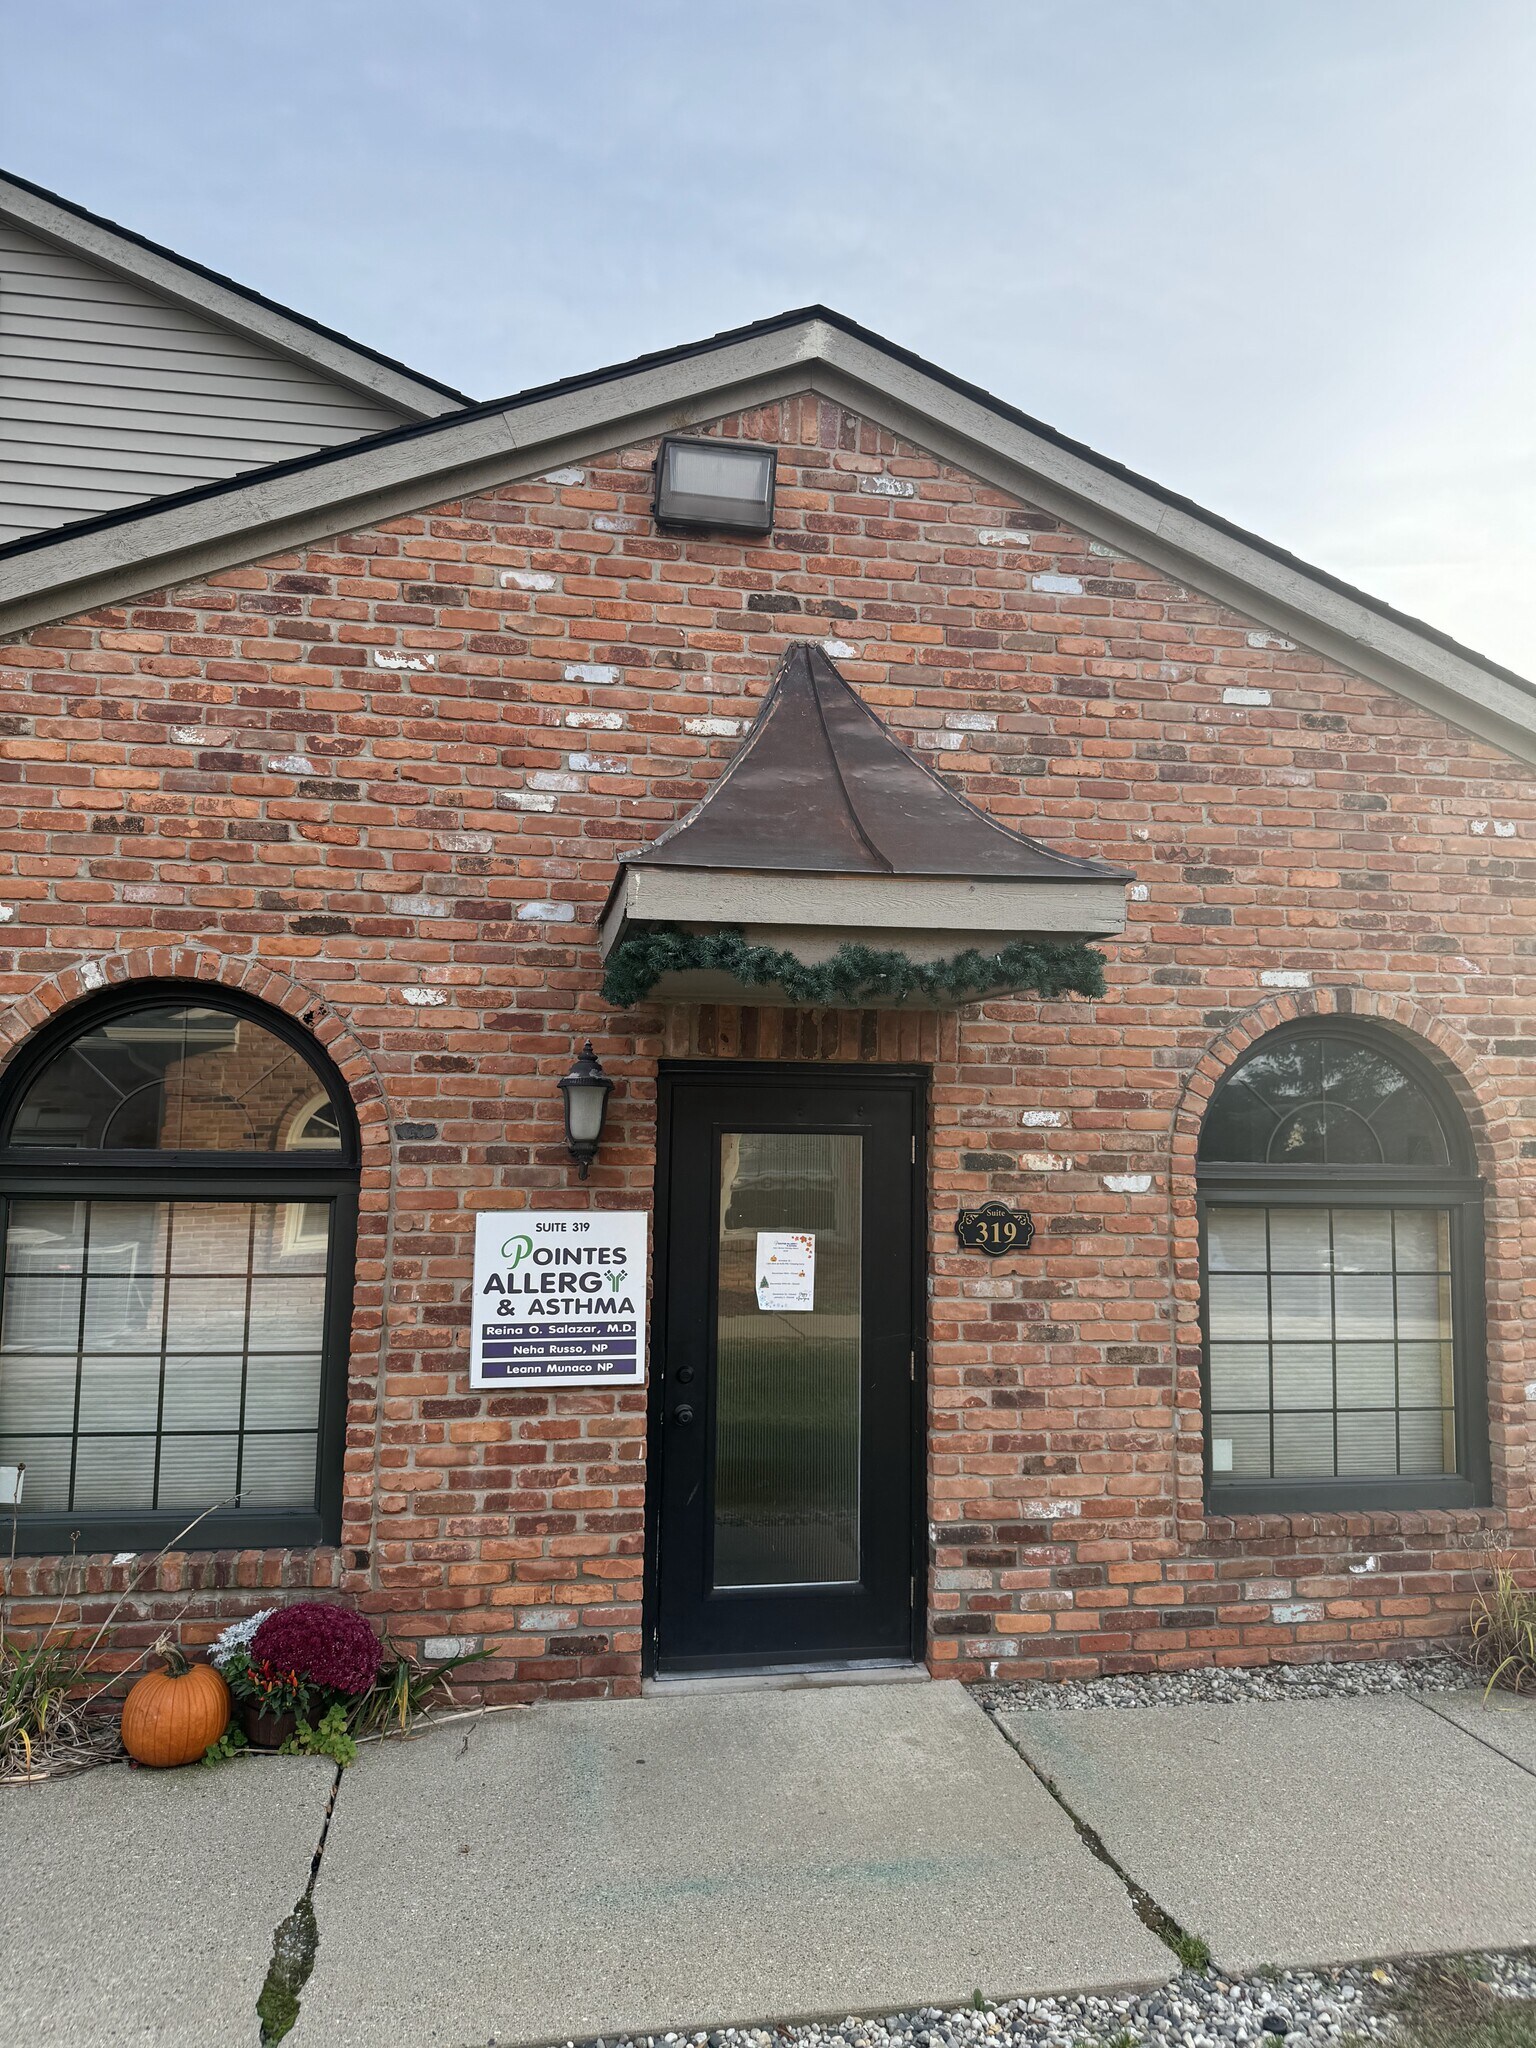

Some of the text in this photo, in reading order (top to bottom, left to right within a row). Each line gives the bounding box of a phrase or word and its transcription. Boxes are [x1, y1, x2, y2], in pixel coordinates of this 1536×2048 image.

[986, 1209, 1006, 1217] Suite
[535, 1222, 591, 1232] SUITE 319
[975, 1222, 1017, 1243] 319
[501, 1234, 628, 1270] POINTES
[483, 1269, 628, 1295] ALLERGY
[496, 1297, 636, 1316] & ASTHMA
[486, 1323, 635, 1336] Reina O. Salazar, M.D.
[513, 1343, 609, 1355] Neha Russo, NP
[506, 1362, 614, 1374] Leann Munaco NP
